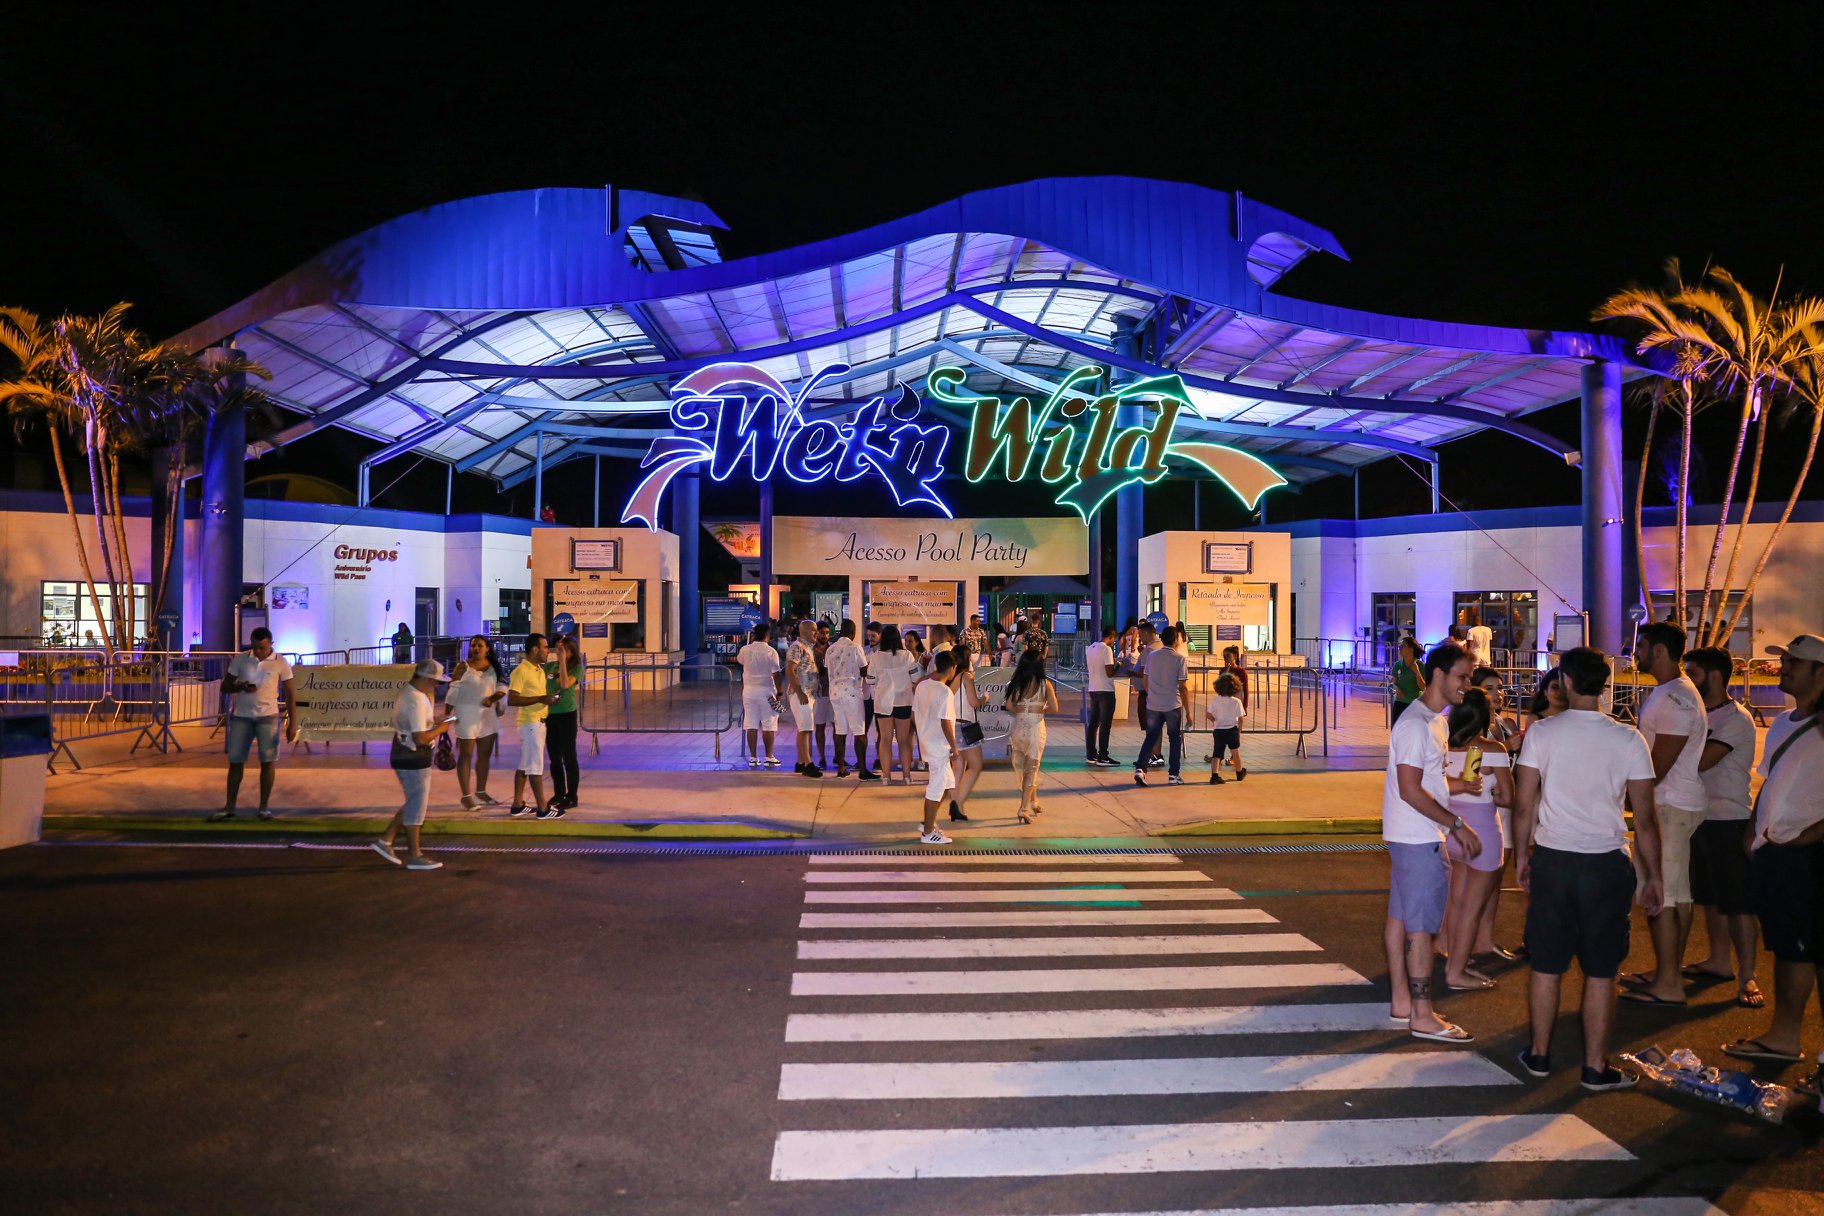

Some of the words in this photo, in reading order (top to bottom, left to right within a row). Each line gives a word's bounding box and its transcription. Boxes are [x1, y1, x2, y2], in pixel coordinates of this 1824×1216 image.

[926, 365, 1188, 500] Wild
[334, 544, 399, 564] Grupos
[825, 532, 906, 561] Acesso
[916, 532, 964, 561] Pool
[971, 532, 1028, 568] Party
[1191, 588, 1222, 599] Retirada
[1223, 588, 1232, 599] de
[297, 672, 343, 690] Acesso
[346, 678, 392, 690] catraca
[310, 697, 358, 715] ingresso
[362, 700, 378, 710] na
